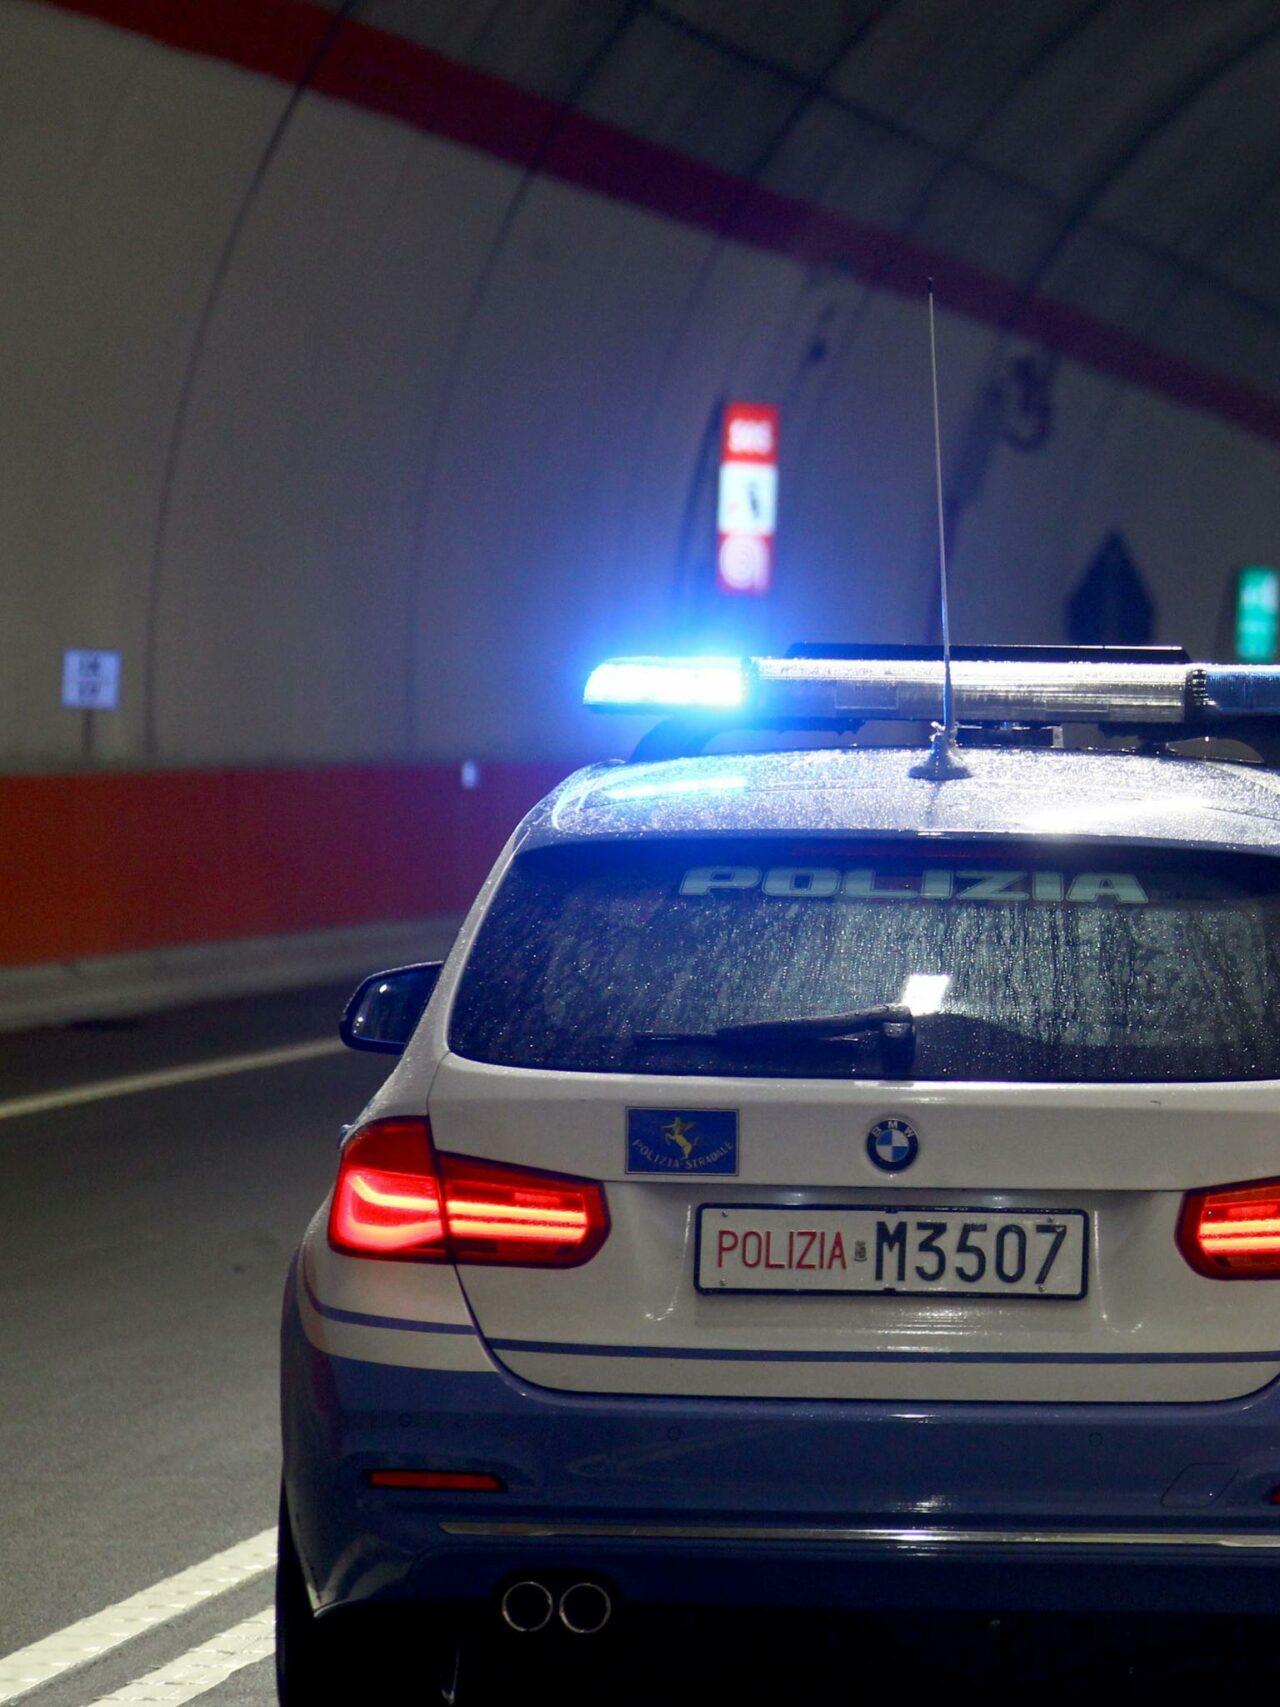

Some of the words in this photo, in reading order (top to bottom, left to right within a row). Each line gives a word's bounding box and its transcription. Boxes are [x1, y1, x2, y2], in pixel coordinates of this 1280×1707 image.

[679, 867, 1149, 903] POLIZIA
[872, 1120, 915, 1138] BMW
[631, 1138, 680, 1169] POLIZIA
[684, 1141, 733, 1170] STRADALE
[717, 1229, 847, 1270] POLIZIA
[875, 1220, 1068, 1285] M3507
